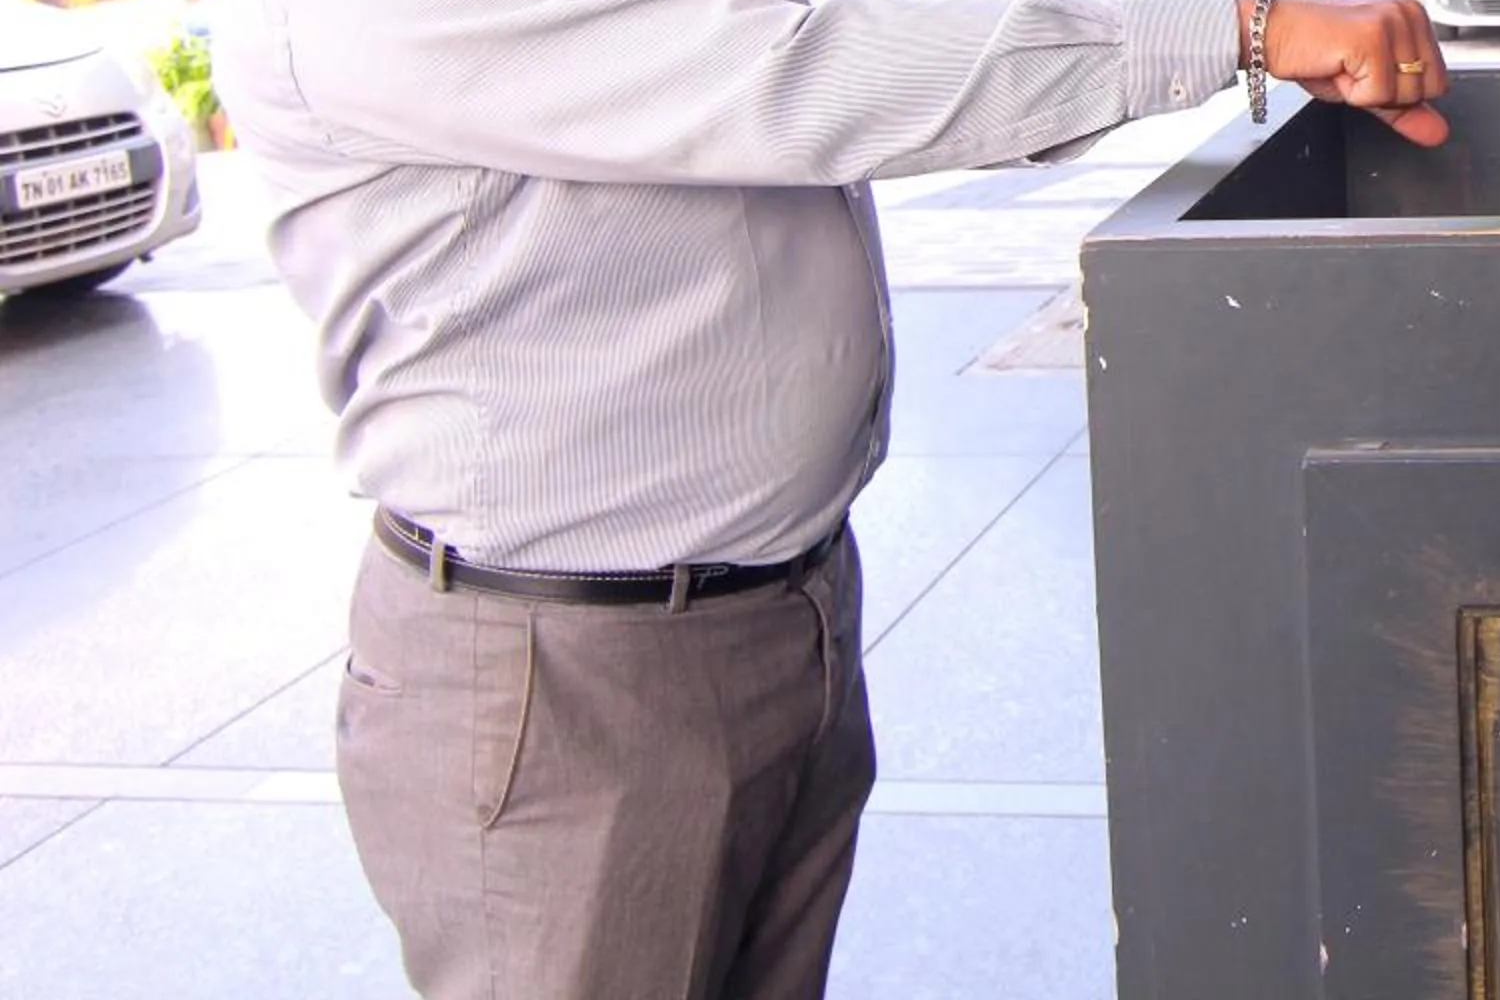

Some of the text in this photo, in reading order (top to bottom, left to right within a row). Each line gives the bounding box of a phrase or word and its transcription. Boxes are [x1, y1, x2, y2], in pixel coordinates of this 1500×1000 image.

[22, 182, 43, 201] TN
[47, 173, 63, 196] 01
[69, 169, 90, 190] AK
